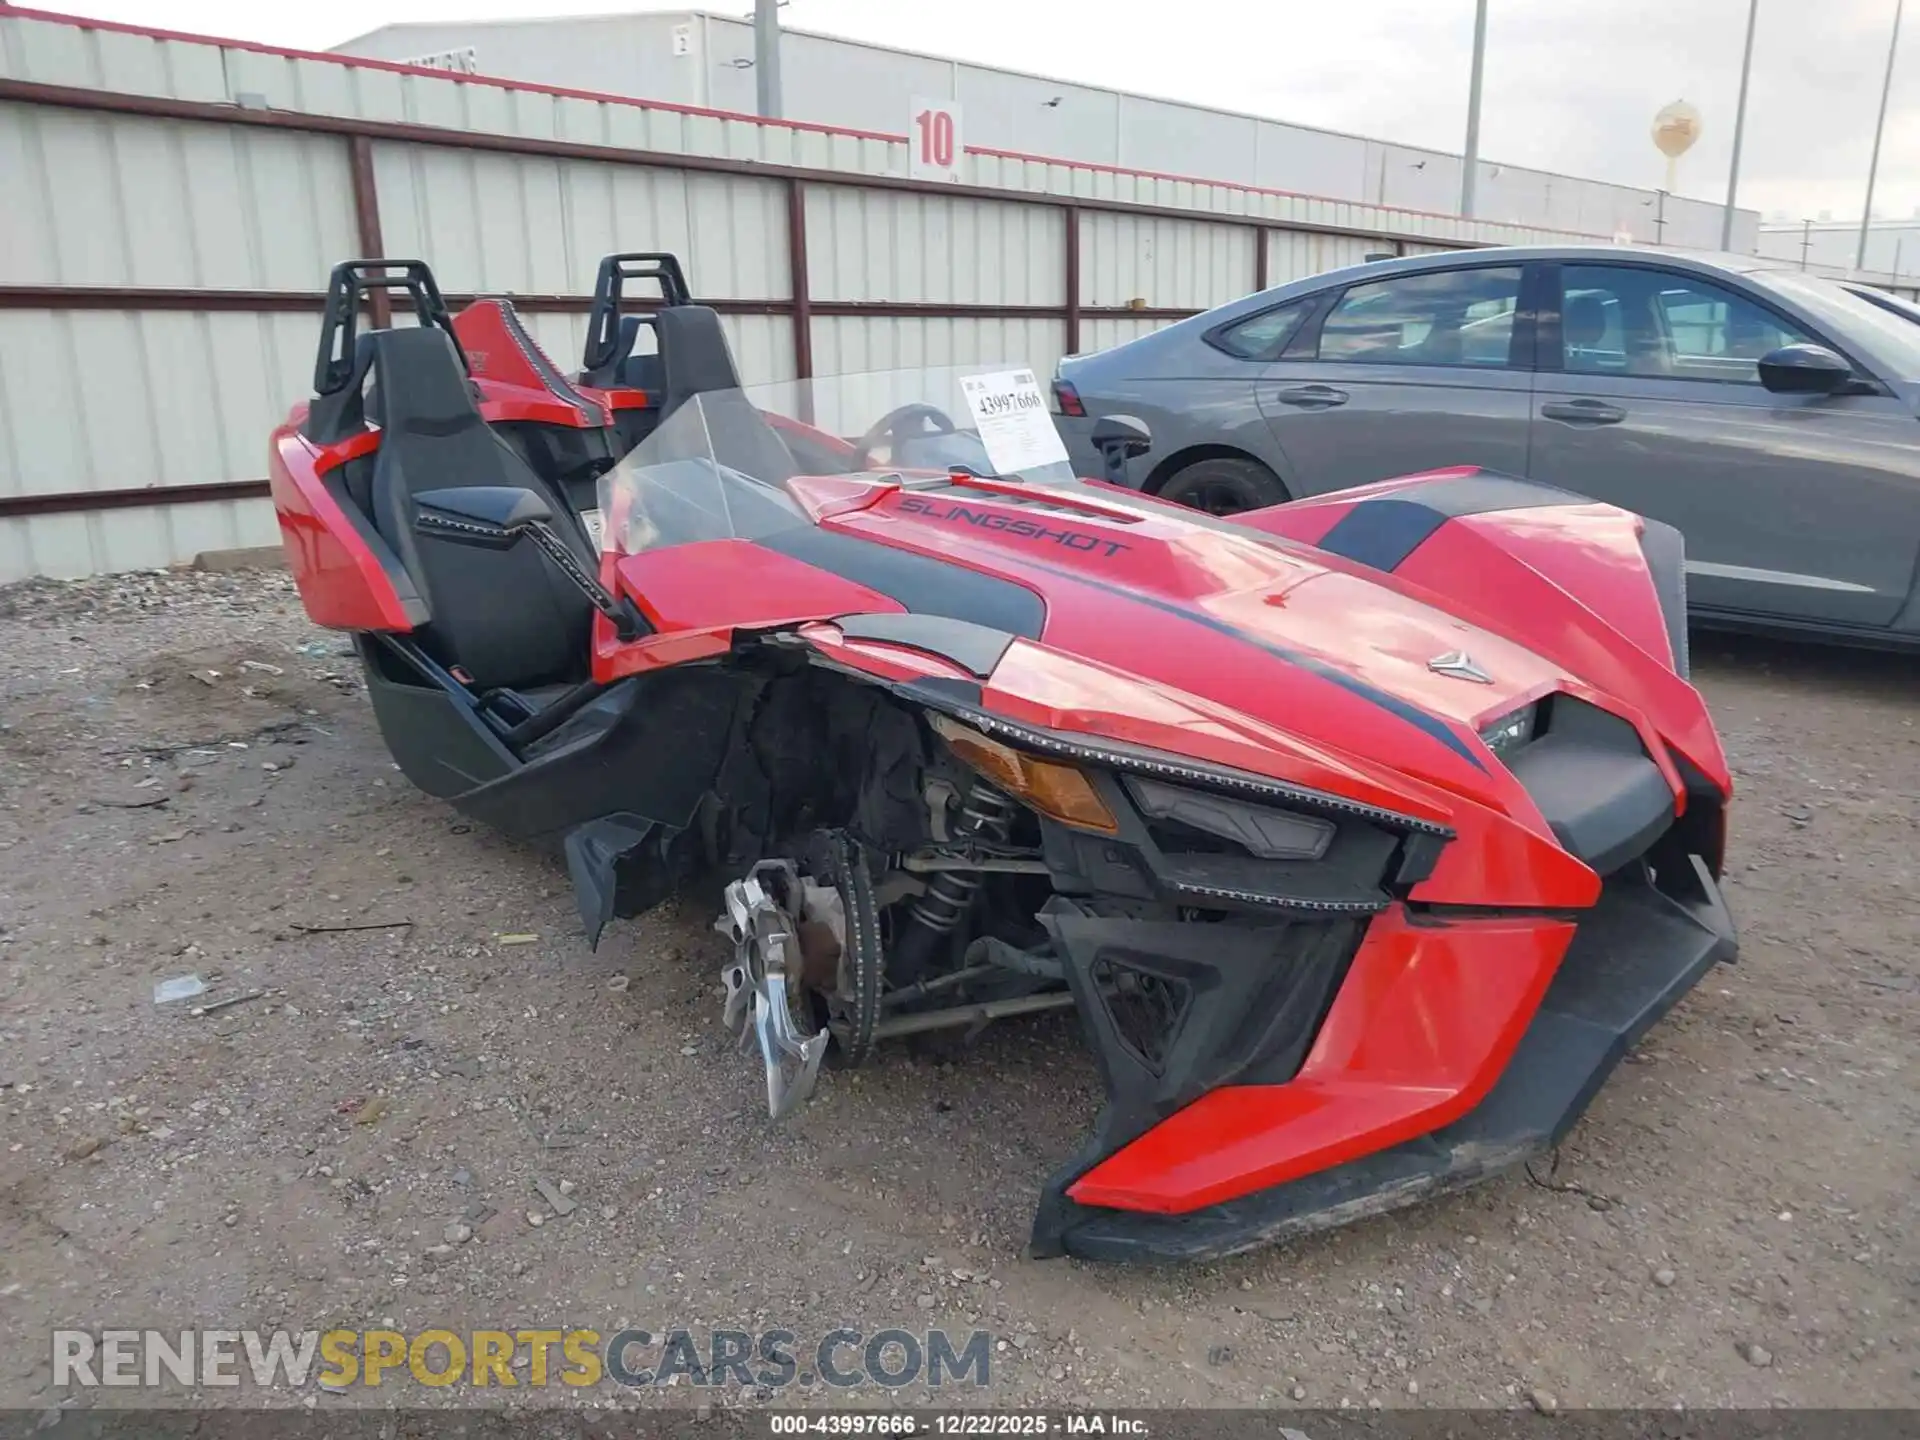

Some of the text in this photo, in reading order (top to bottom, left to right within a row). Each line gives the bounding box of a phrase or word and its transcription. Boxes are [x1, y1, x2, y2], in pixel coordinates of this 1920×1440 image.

[915, 109, 954, 166] 10
[979, 391, 1041, 415] 43997666
[898, 499, 1132, 557] SLINGSHOT
